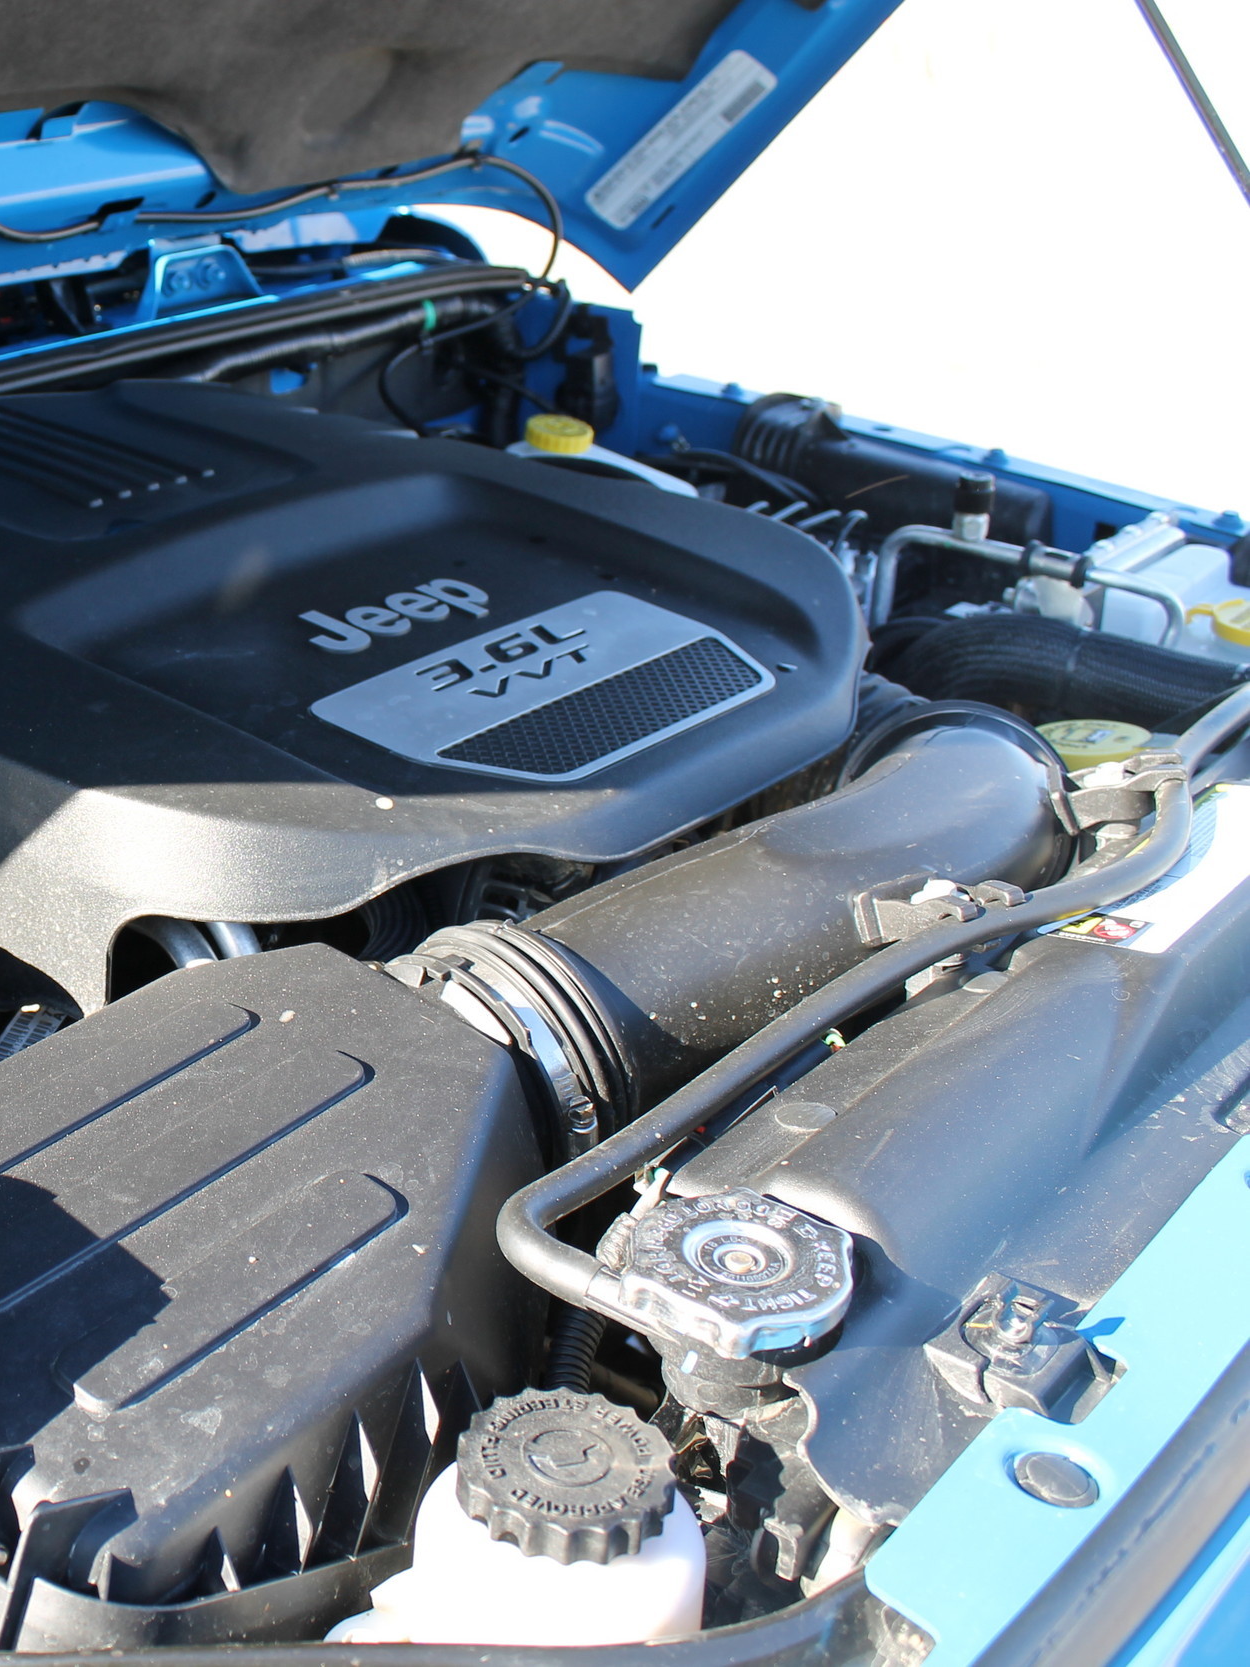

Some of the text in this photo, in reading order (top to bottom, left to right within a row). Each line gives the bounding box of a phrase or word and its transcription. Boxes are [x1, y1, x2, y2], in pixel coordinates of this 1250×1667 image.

[299, 577, 490, 655] Jeep
[415, 624, 587, 692] 3.6L
[468, 644, 588, 698] VVT
[742, 1240, 837, 1312] KEEP TIGHT
[479, 1397, 654, 1480] POWER STEERING FLUID
[510, 1487, 631, 1517] APPROVED
